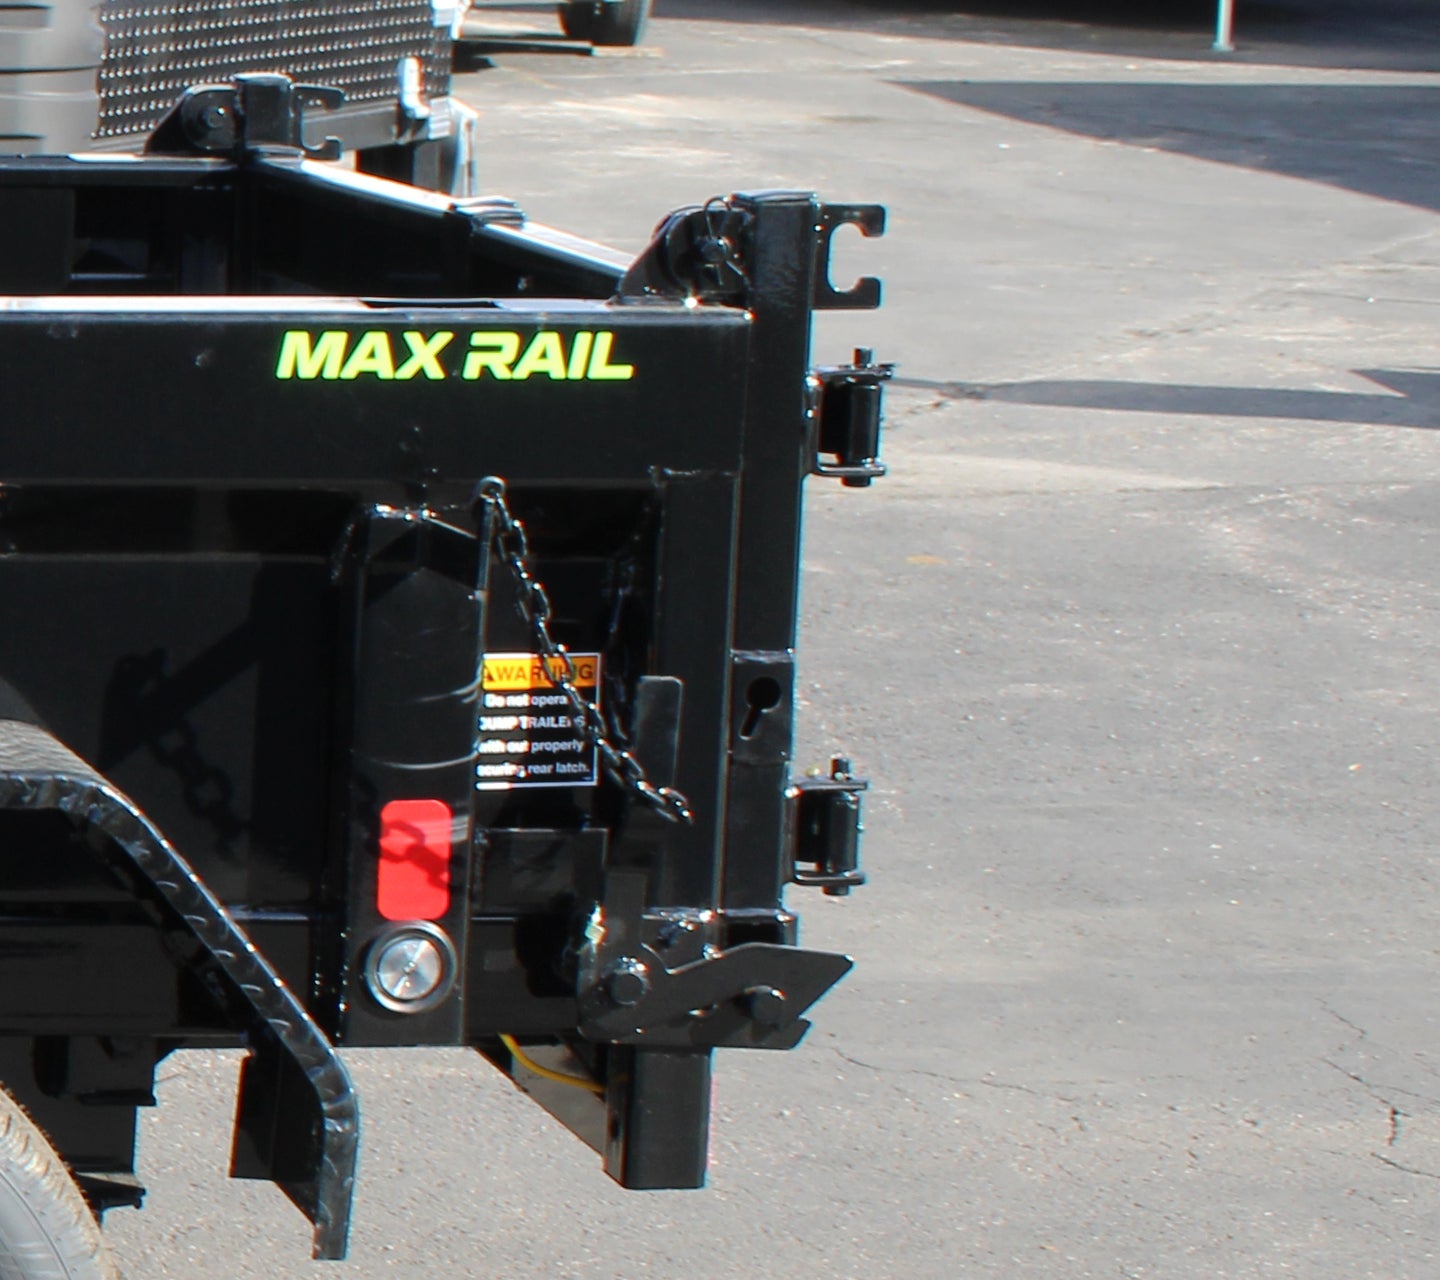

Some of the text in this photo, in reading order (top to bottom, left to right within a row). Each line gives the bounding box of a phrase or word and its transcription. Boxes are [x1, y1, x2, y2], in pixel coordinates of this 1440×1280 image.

[275, 330, 636, 381] MAX RAIL
[484, 693, 505, 707] Do
[506, 693, 529, 708] not
[530, 739, 584, 754] properly
[527, 763, 553, 774] rear
